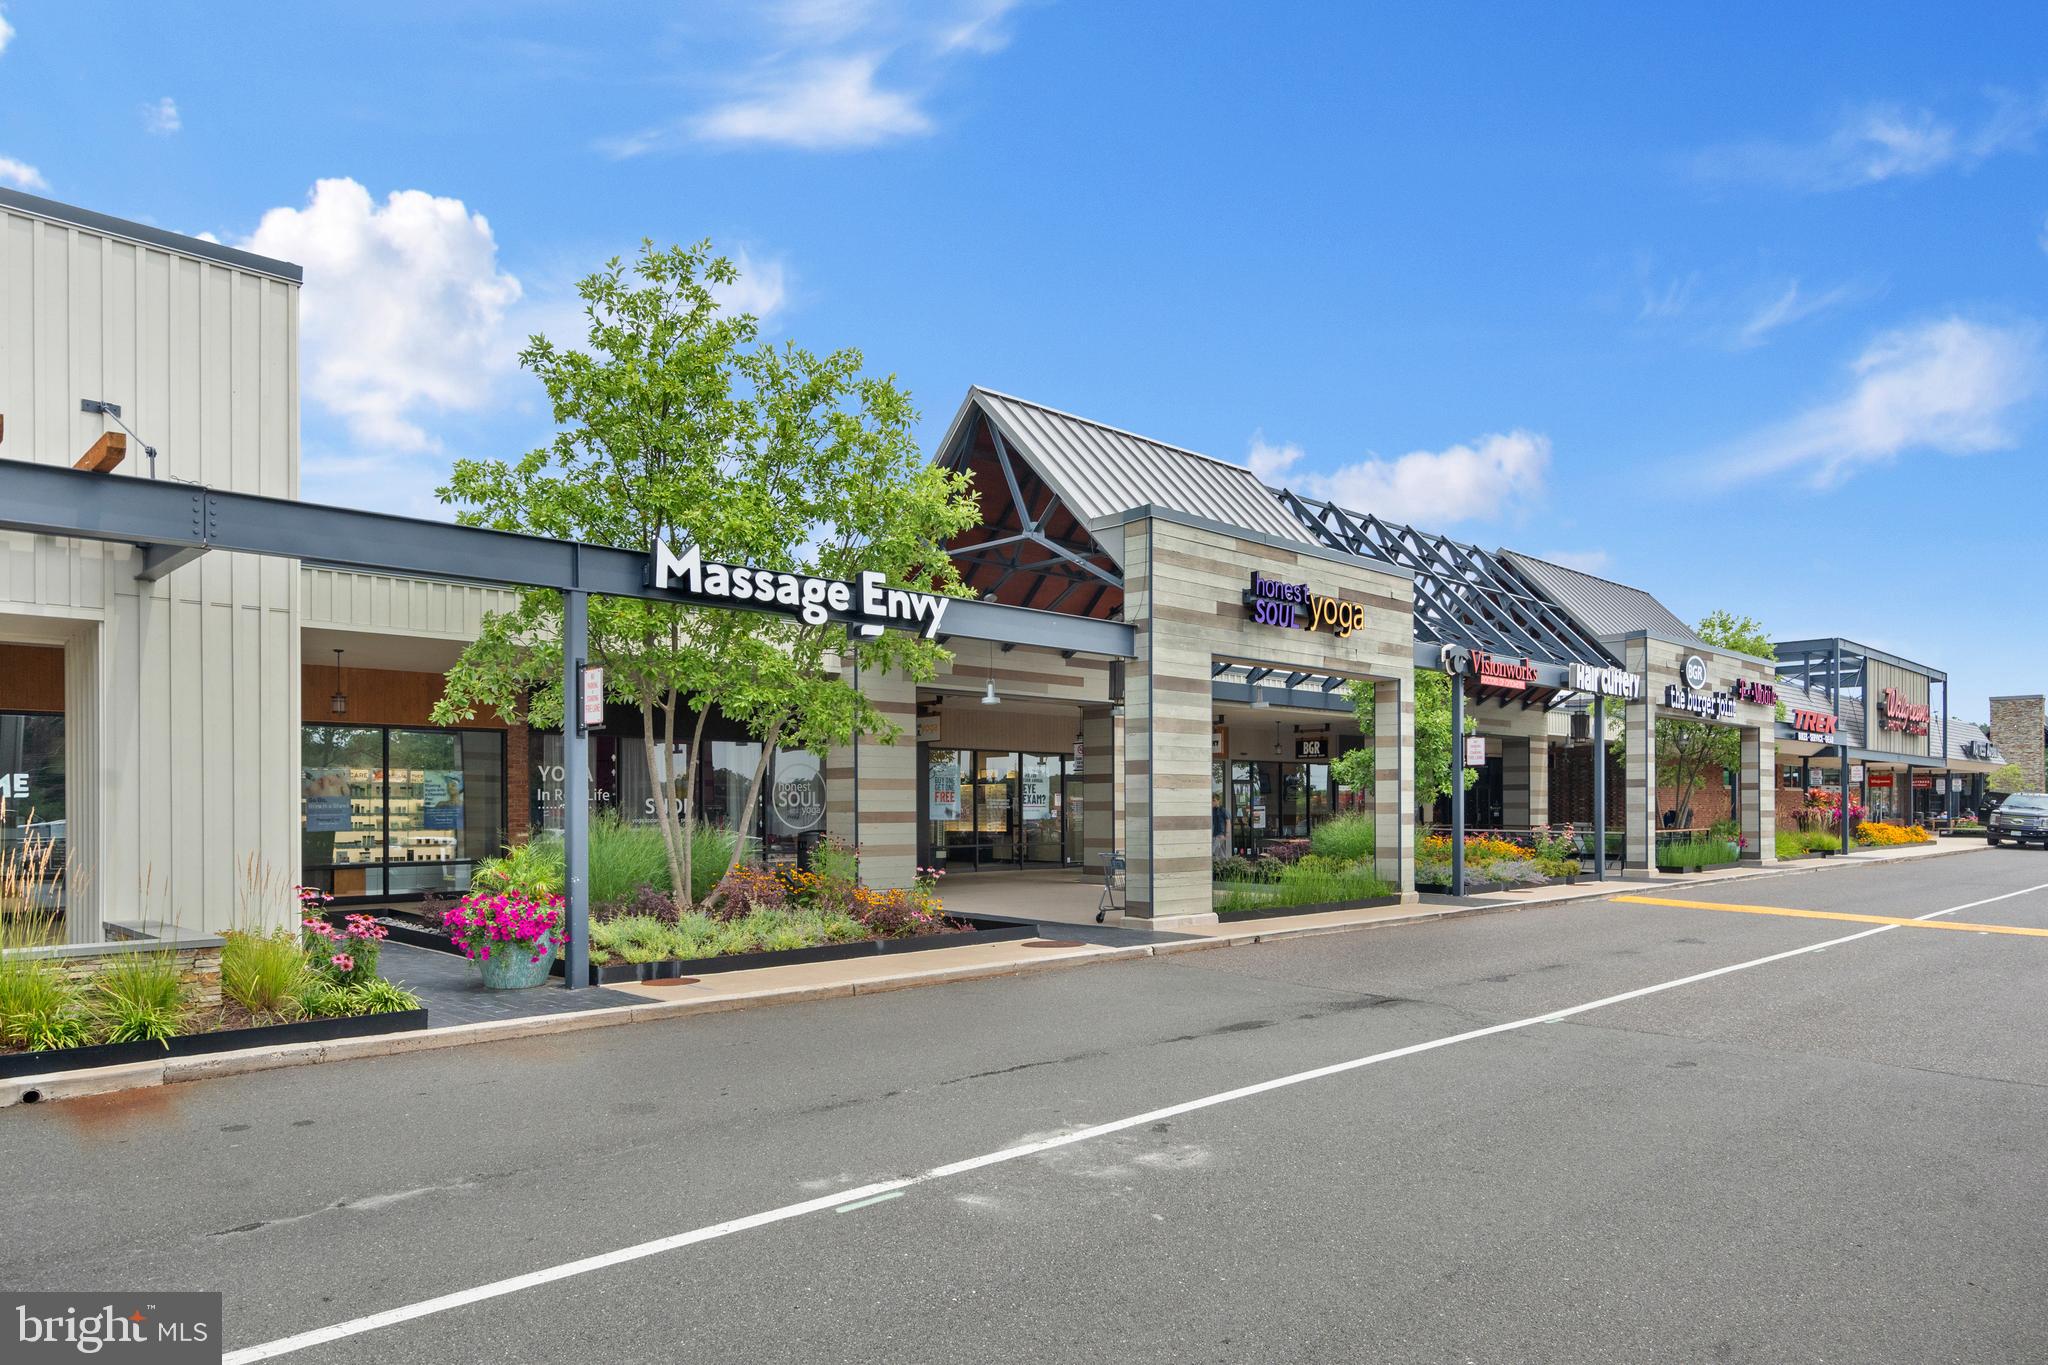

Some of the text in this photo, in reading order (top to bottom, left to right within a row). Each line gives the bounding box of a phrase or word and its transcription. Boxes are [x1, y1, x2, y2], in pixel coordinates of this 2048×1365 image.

[654, 536, 950, 639] Massage Envy
[1254, 571, 1310, 605] honest
[1254, 598, 1300, 629] SOUL
[1309, 593, 1366, 638] yoga
[1471, 649, 1538, 682] Visionworks
[1688, 664, 1703, 681] BGR
[1576, 663, 1600, 693] Hair
[1670, 685, 1737, 720] the burger joint
[1886, 688, 1930, 730] Walgreens
[1792, 709, 1838, 734] TREK
[1303, 741, 1321, 755] BGR
[537, 788, 550, 801] In
[778, 782, 812, 792] honest
[934, 791, 956, 803] FREE
[1023, 783, 1037, 794] EYE
[778, 791, 821, 807] SOUL
[1023, 794, 1047, 805] EXAM?
[801, 807, 821, 816] yoga
